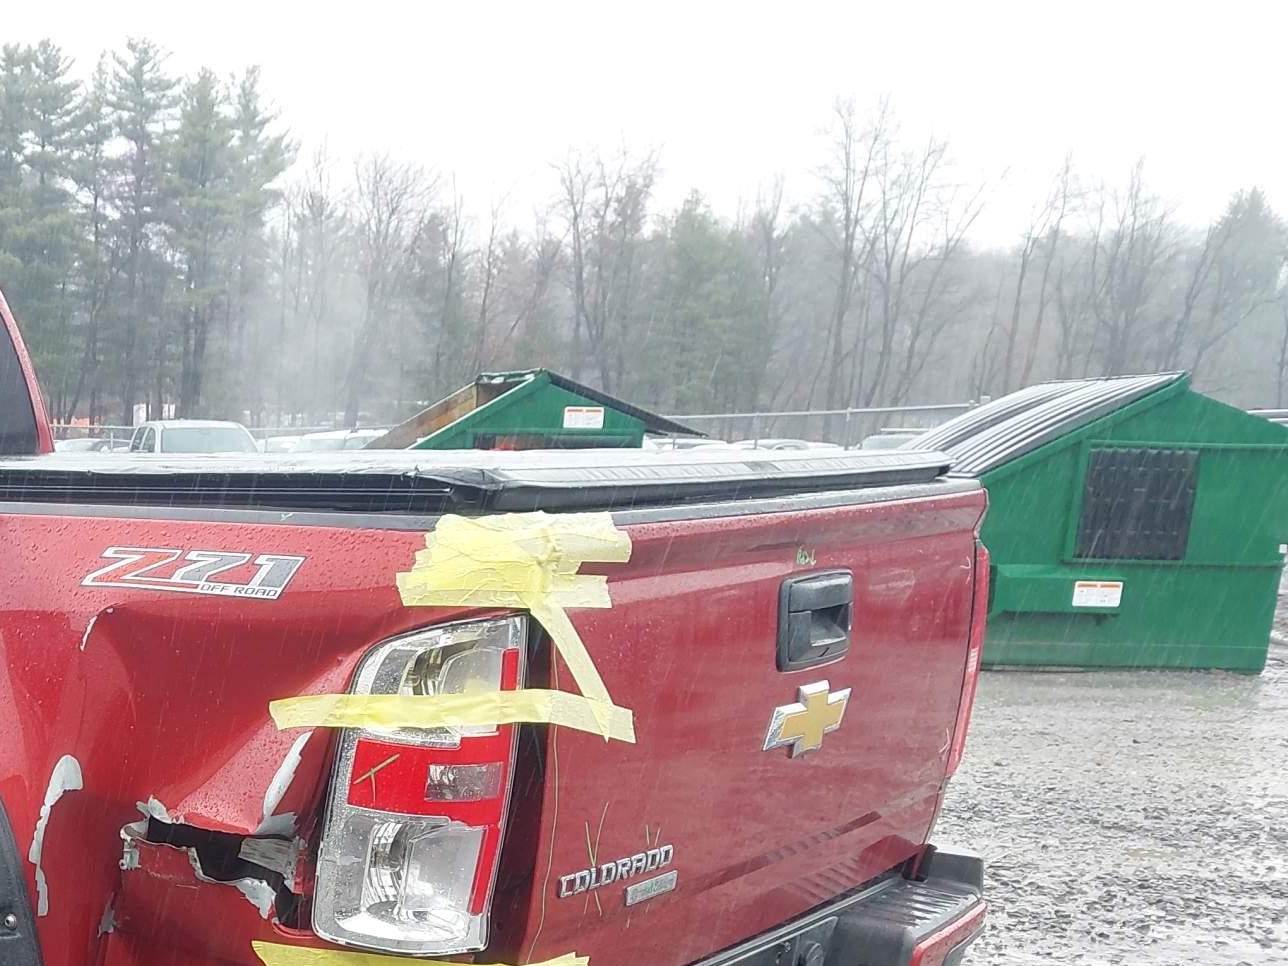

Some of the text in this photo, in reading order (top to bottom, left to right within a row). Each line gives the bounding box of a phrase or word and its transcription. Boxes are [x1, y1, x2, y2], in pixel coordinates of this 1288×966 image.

[80, 545, 307, 592] Z71
[200, 583, 279, 597] OFF ROAD
[560, 844, 674, 898] COLORADO
